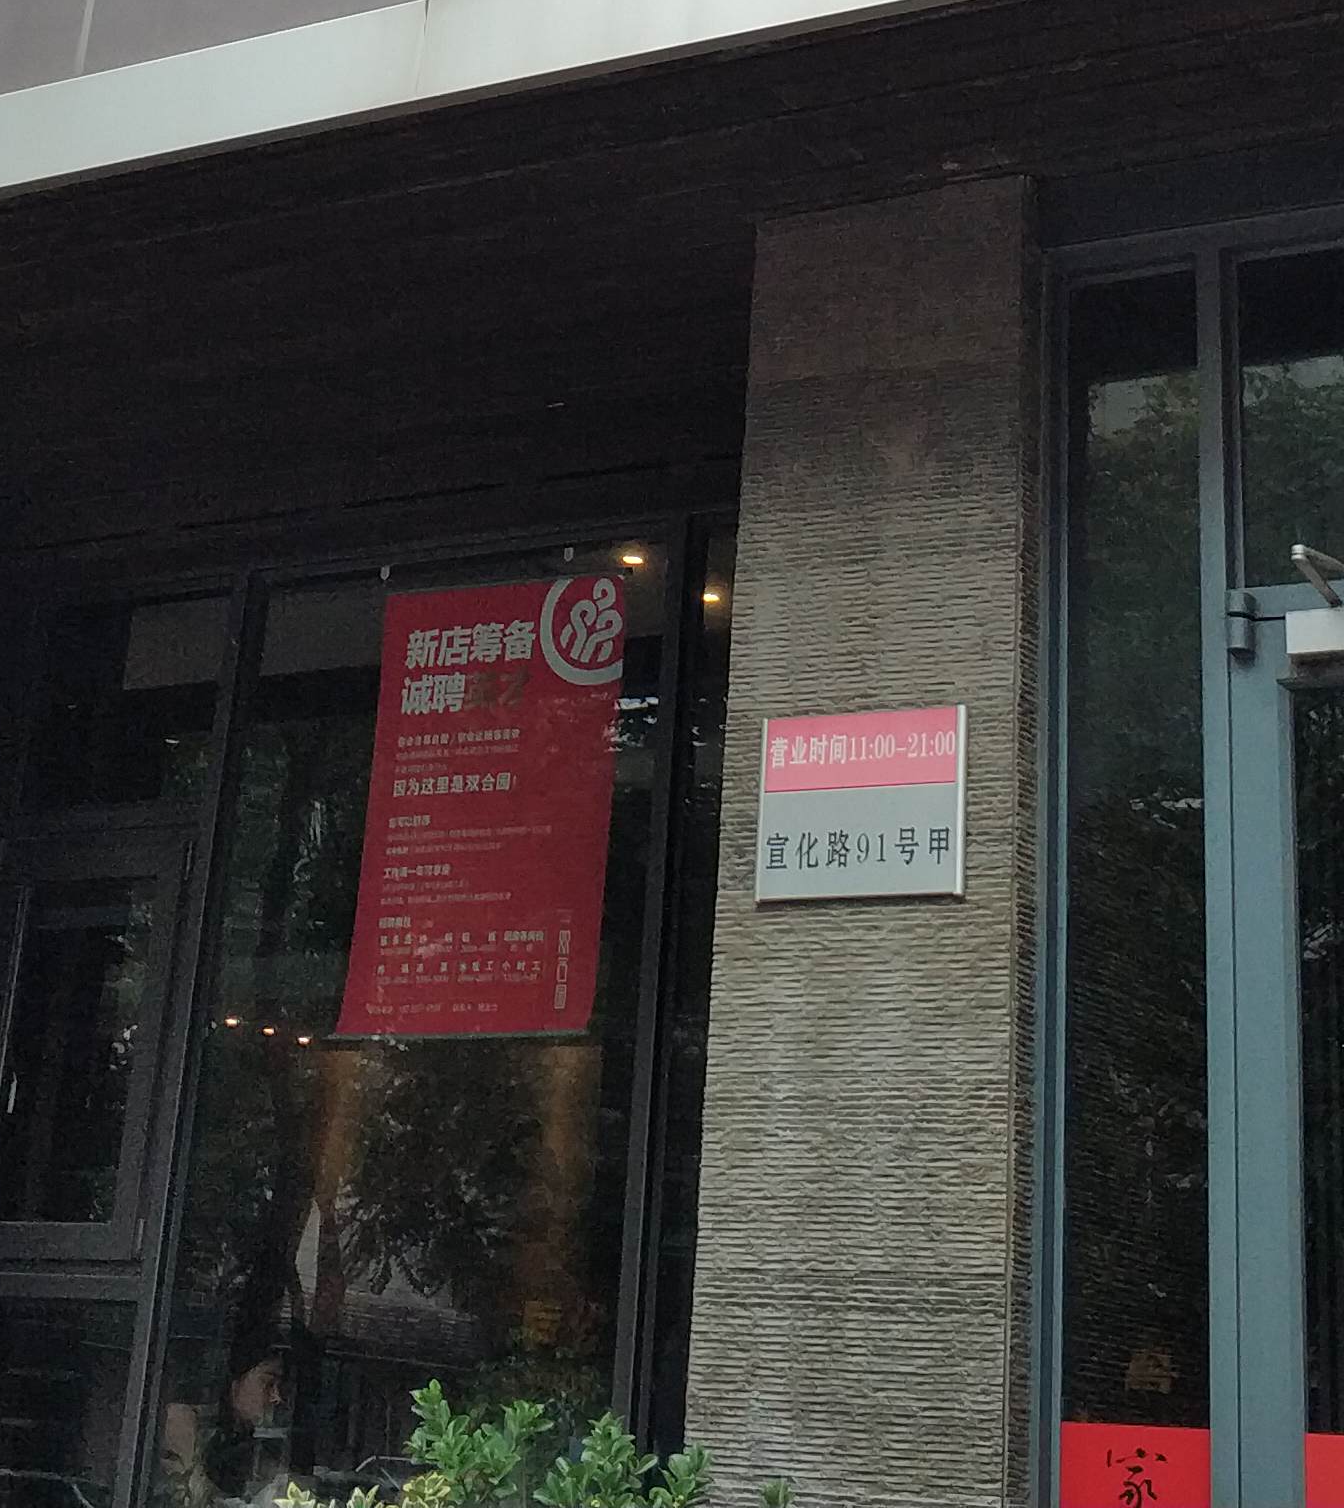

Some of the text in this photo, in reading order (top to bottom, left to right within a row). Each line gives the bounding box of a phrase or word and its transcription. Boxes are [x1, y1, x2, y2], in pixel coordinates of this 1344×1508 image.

[406, 620, 536, 669] 新店筹备
[770, 731, 956, 768] 营业时间11:00-21:00
[766, 826, 951, 870] 宣化路91号甲
